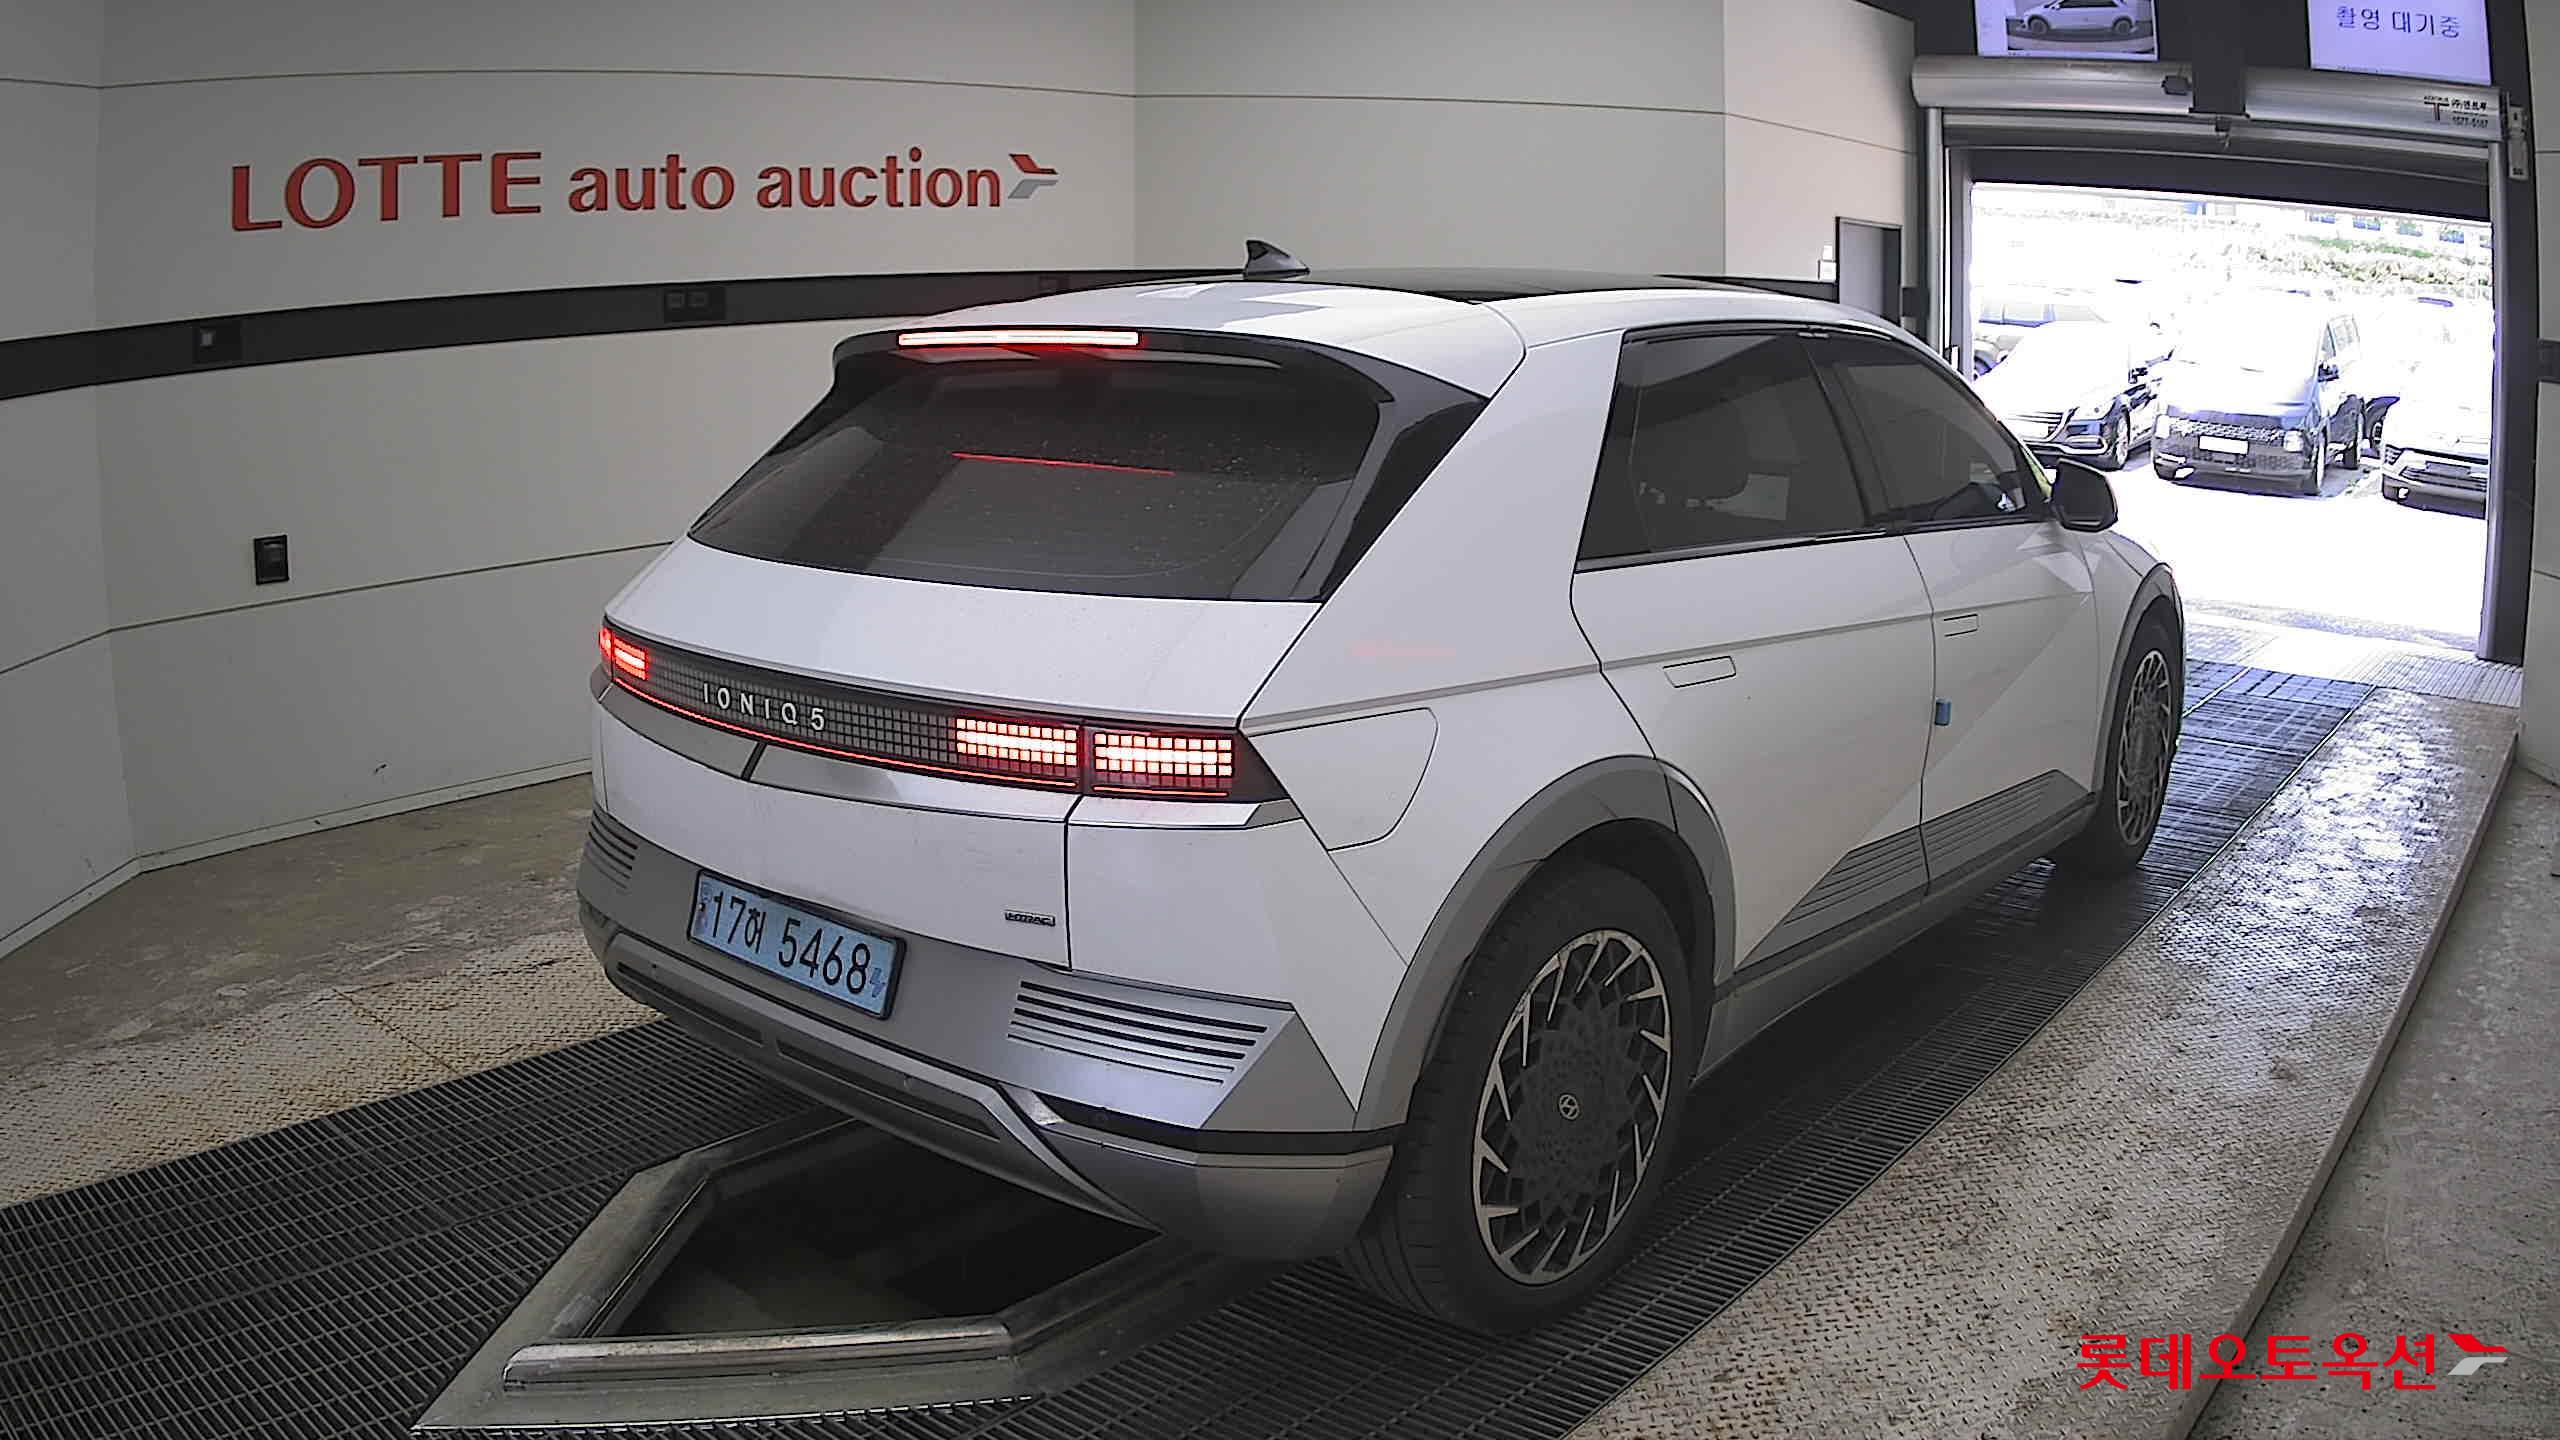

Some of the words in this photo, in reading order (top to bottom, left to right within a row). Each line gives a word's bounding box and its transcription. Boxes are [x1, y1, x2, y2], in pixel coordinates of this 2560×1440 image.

[2336, 5, 2381, 31] 촬영
[2391, 11, 2461, 39] 대기중
[231, 152, 542, 232] LOTTE
[568, 153, 735, 212] auto
[756, 146, 1001, 208] auction
[703, 682, 798, 726] IONIQ
[811, 707, 825, 731] 5
[711, 890, 767, 954] 17허
[778, 917, 871, 995] 5468
